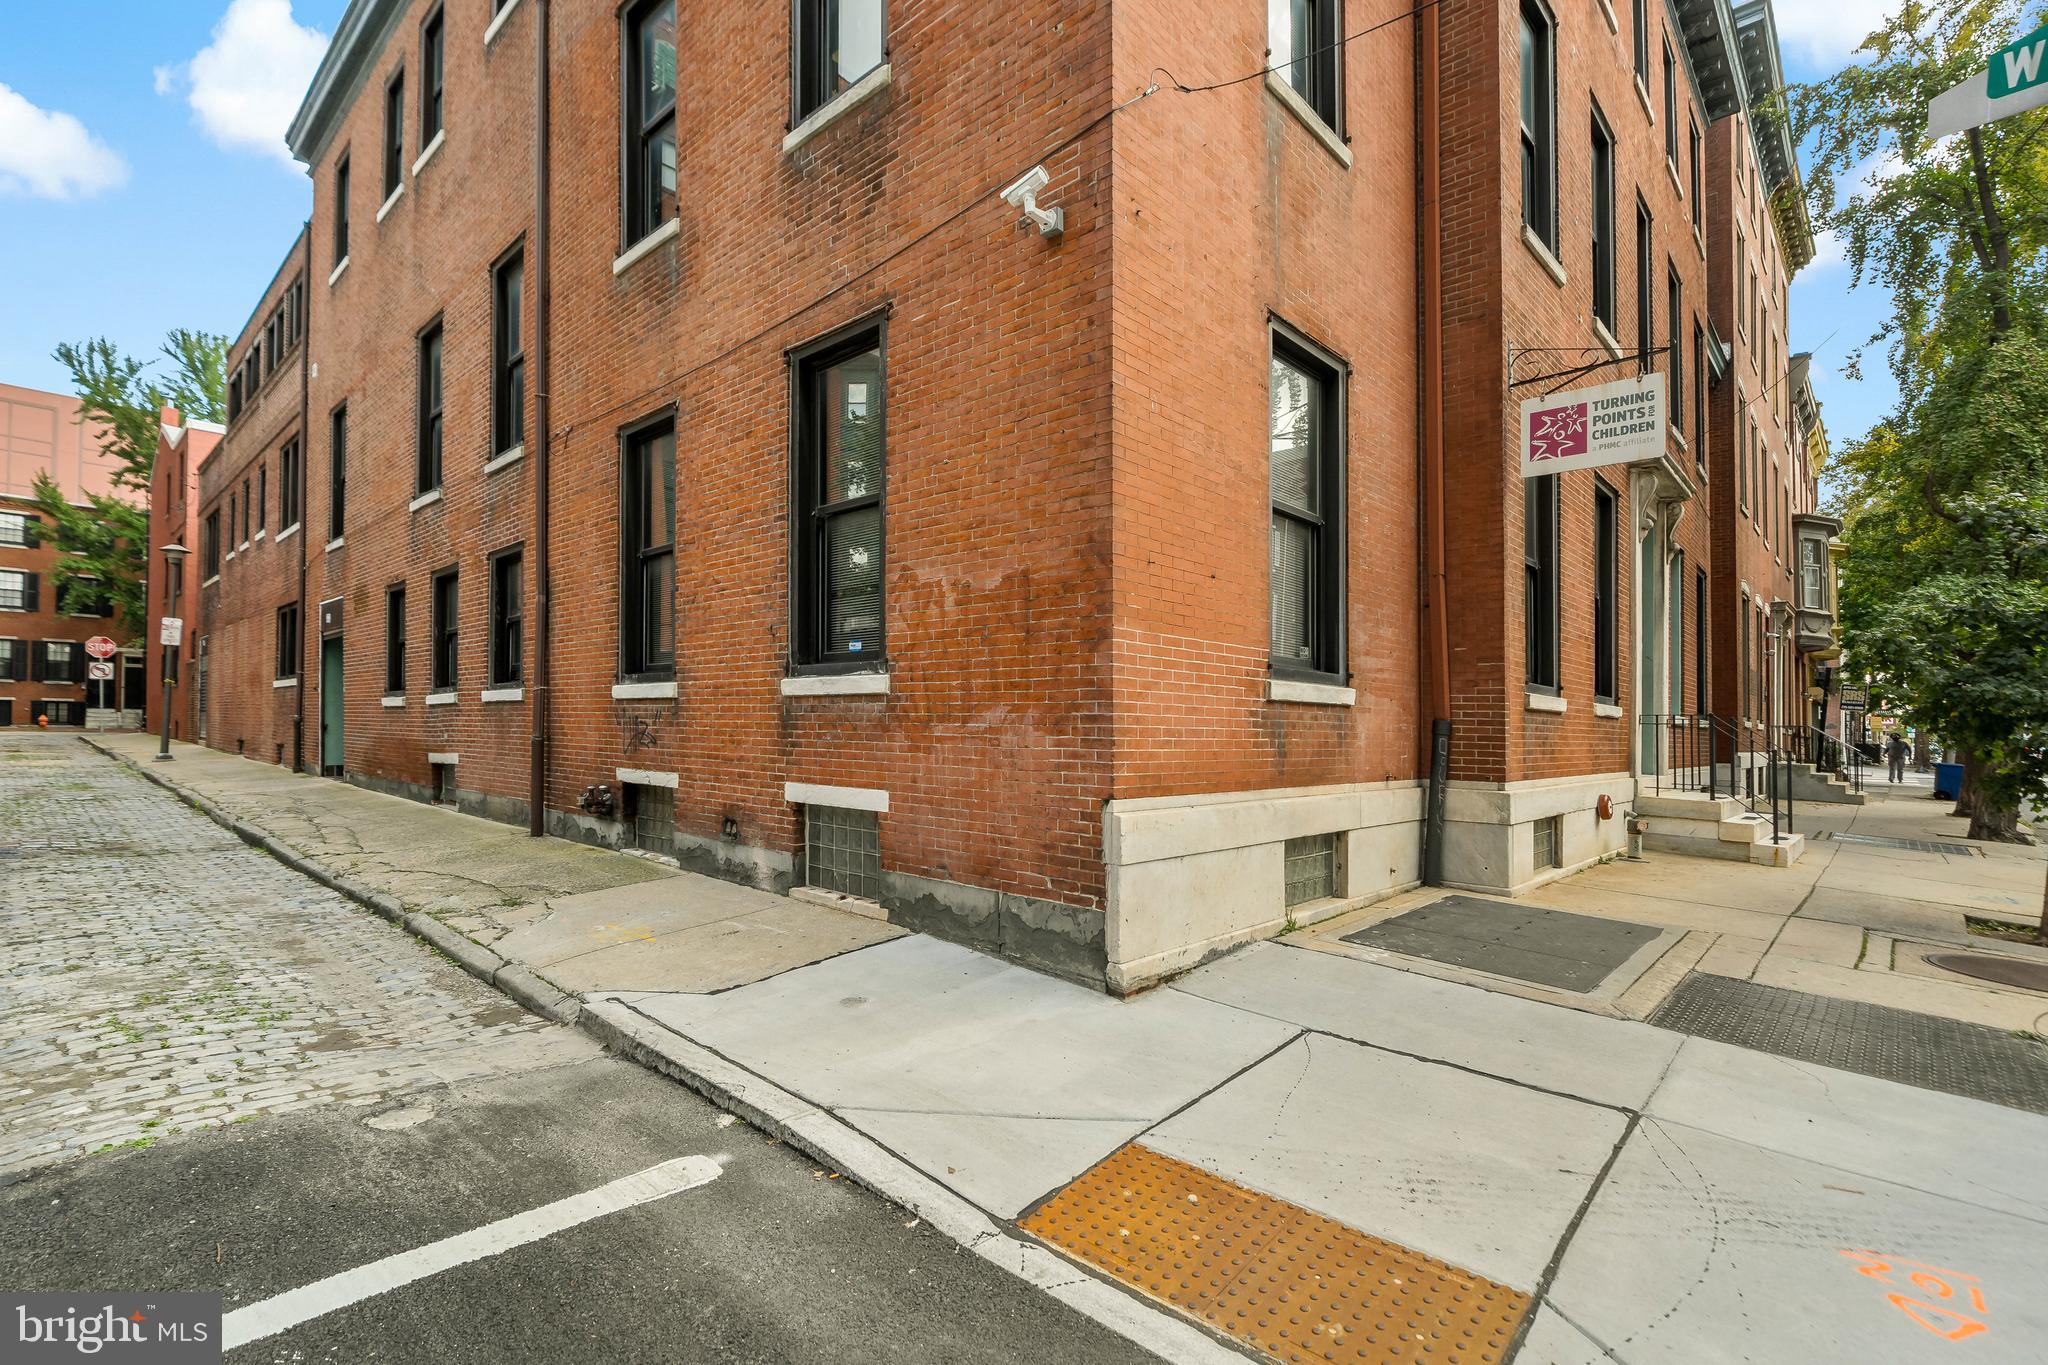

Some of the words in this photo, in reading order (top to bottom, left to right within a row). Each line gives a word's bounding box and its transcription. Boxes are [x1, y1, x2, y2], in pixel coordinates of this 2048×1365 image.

[1592, 390, 1655, 412] TURNING
[1592, 406, 1646, 427] POINTS
[1648, 404, 1656, 417] FOR
[1592, 420, 1655, 441] CHILDREN
[1598, 441, 1622, 451] PHMC
[1623, 436, 1656, 447] affiliate
[87, 643, 114, 652] STOP
